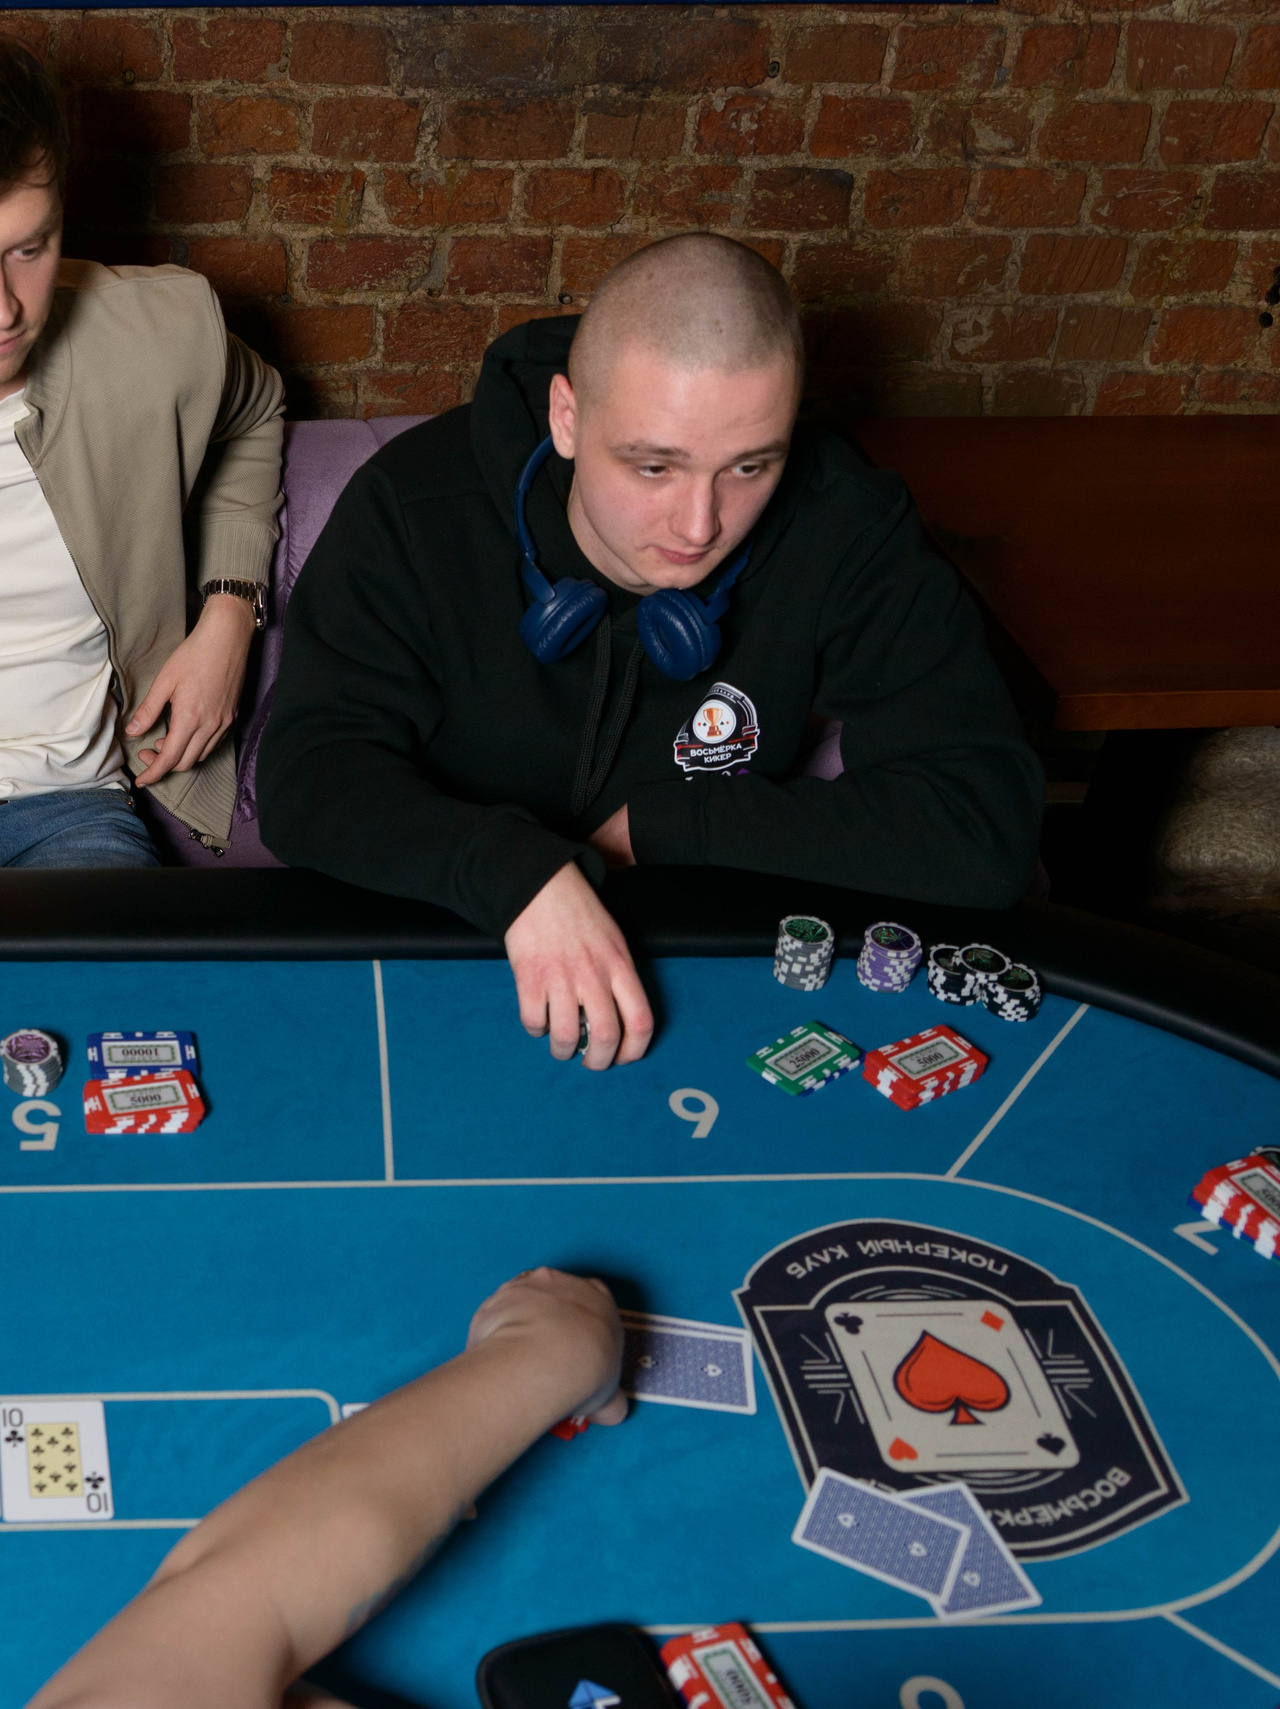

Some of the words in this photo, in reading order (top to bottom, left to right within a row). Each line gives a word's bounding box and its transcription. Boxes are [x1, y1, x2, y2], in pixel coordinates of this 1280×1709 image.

[690, 743, 742, 757] ВОСЬМЁРКА
[703, 753, 732, 764] КИКЕР
[122, 1047, 159, 1057] 10000
[789, 1047, 821, 1070] 25000
[917, 1052, 945, 1069] 5000
[130, 1093, 162, 1106] 5000
[12, 1100, 62, 1151] 5
[785, 1244, 850, 1279] КЛУБ
[856, 1238, 1009, 1277] ПОКЕРНЫЙ
[2, 1407, 24, 1428] 10
[86, 1492, 110, 1513] 10
[986, 1466, 1132, 1527] ВОСЬМЁРК
